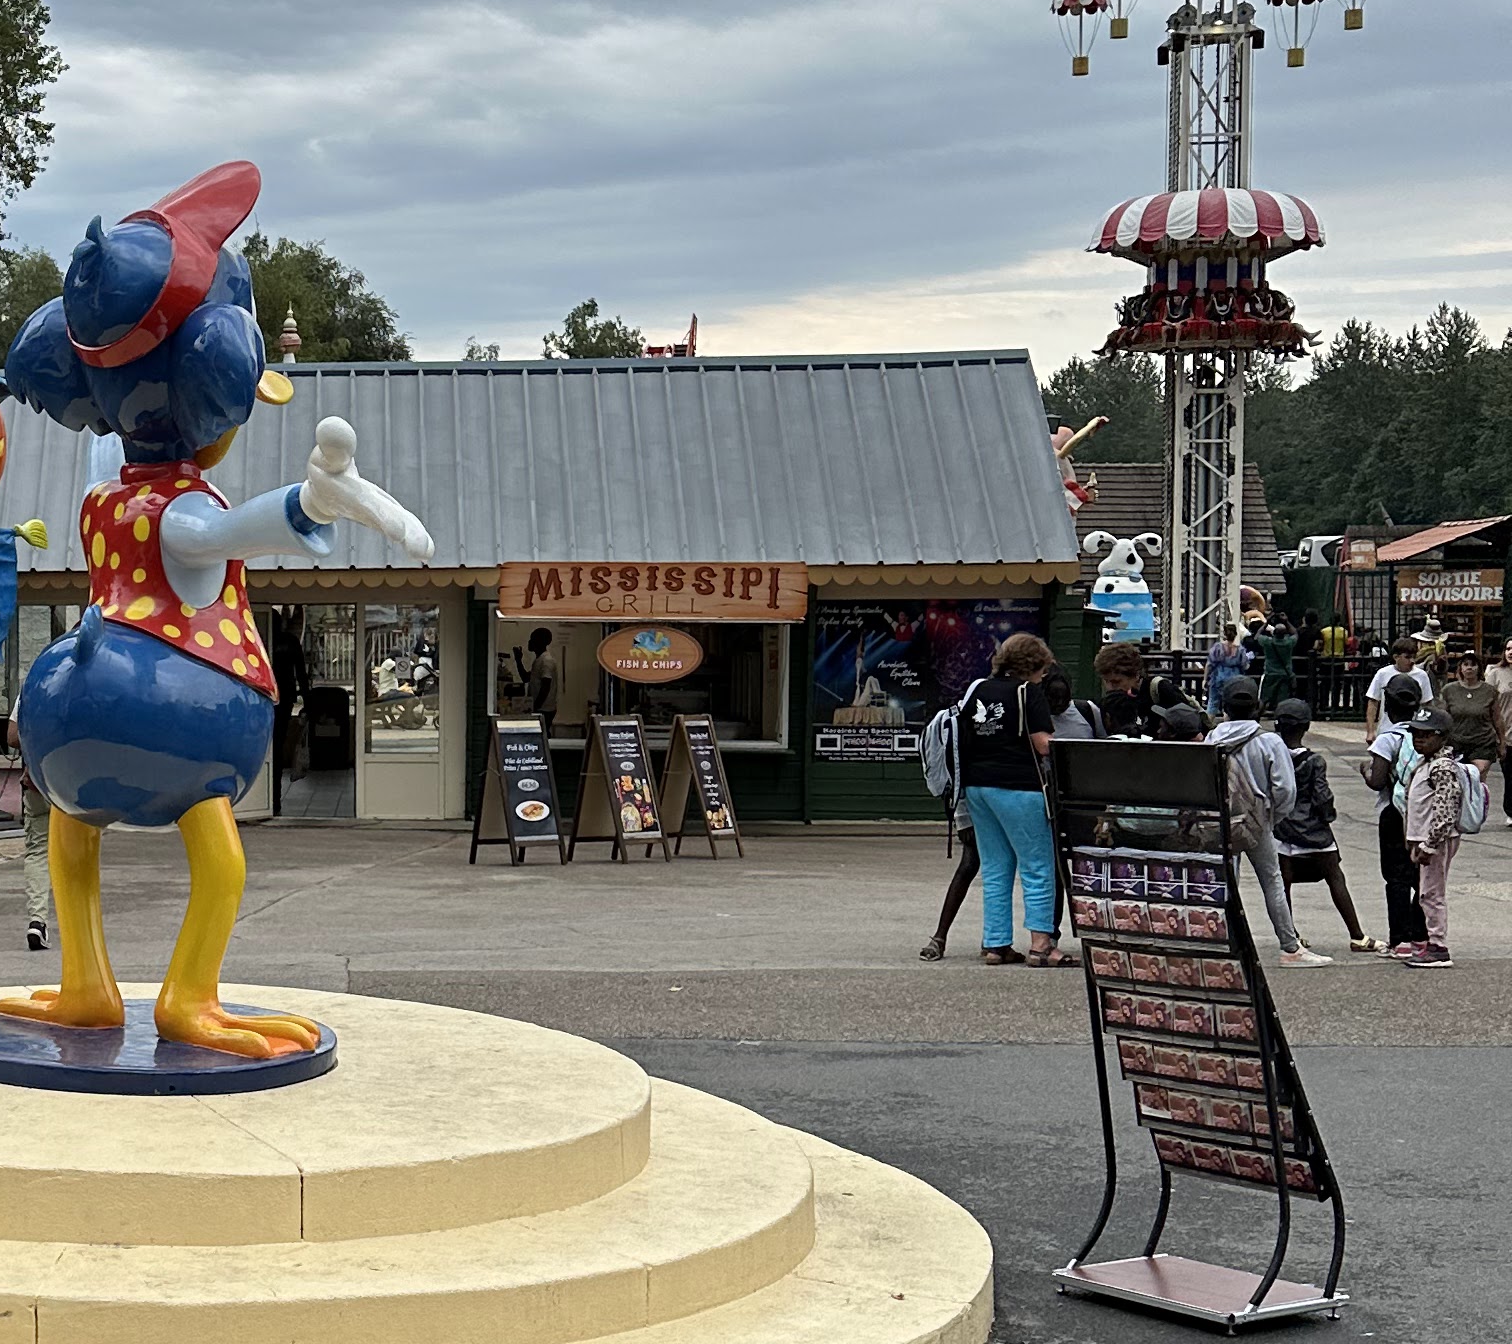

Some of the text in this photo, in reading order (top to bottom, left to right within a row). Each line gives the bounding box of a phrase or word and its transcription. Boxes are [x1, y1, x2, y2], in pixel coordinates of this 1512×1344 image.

[1418, 571, 1482, 587] SORTIE
[521, 565, 781, 610] MISSISSIPI
[1400, 586, 1504, 602] PROVISOIRE
[595, 594, 703, 615] GRILL
[616, 659, 683, 670] FISH & CHIPS
